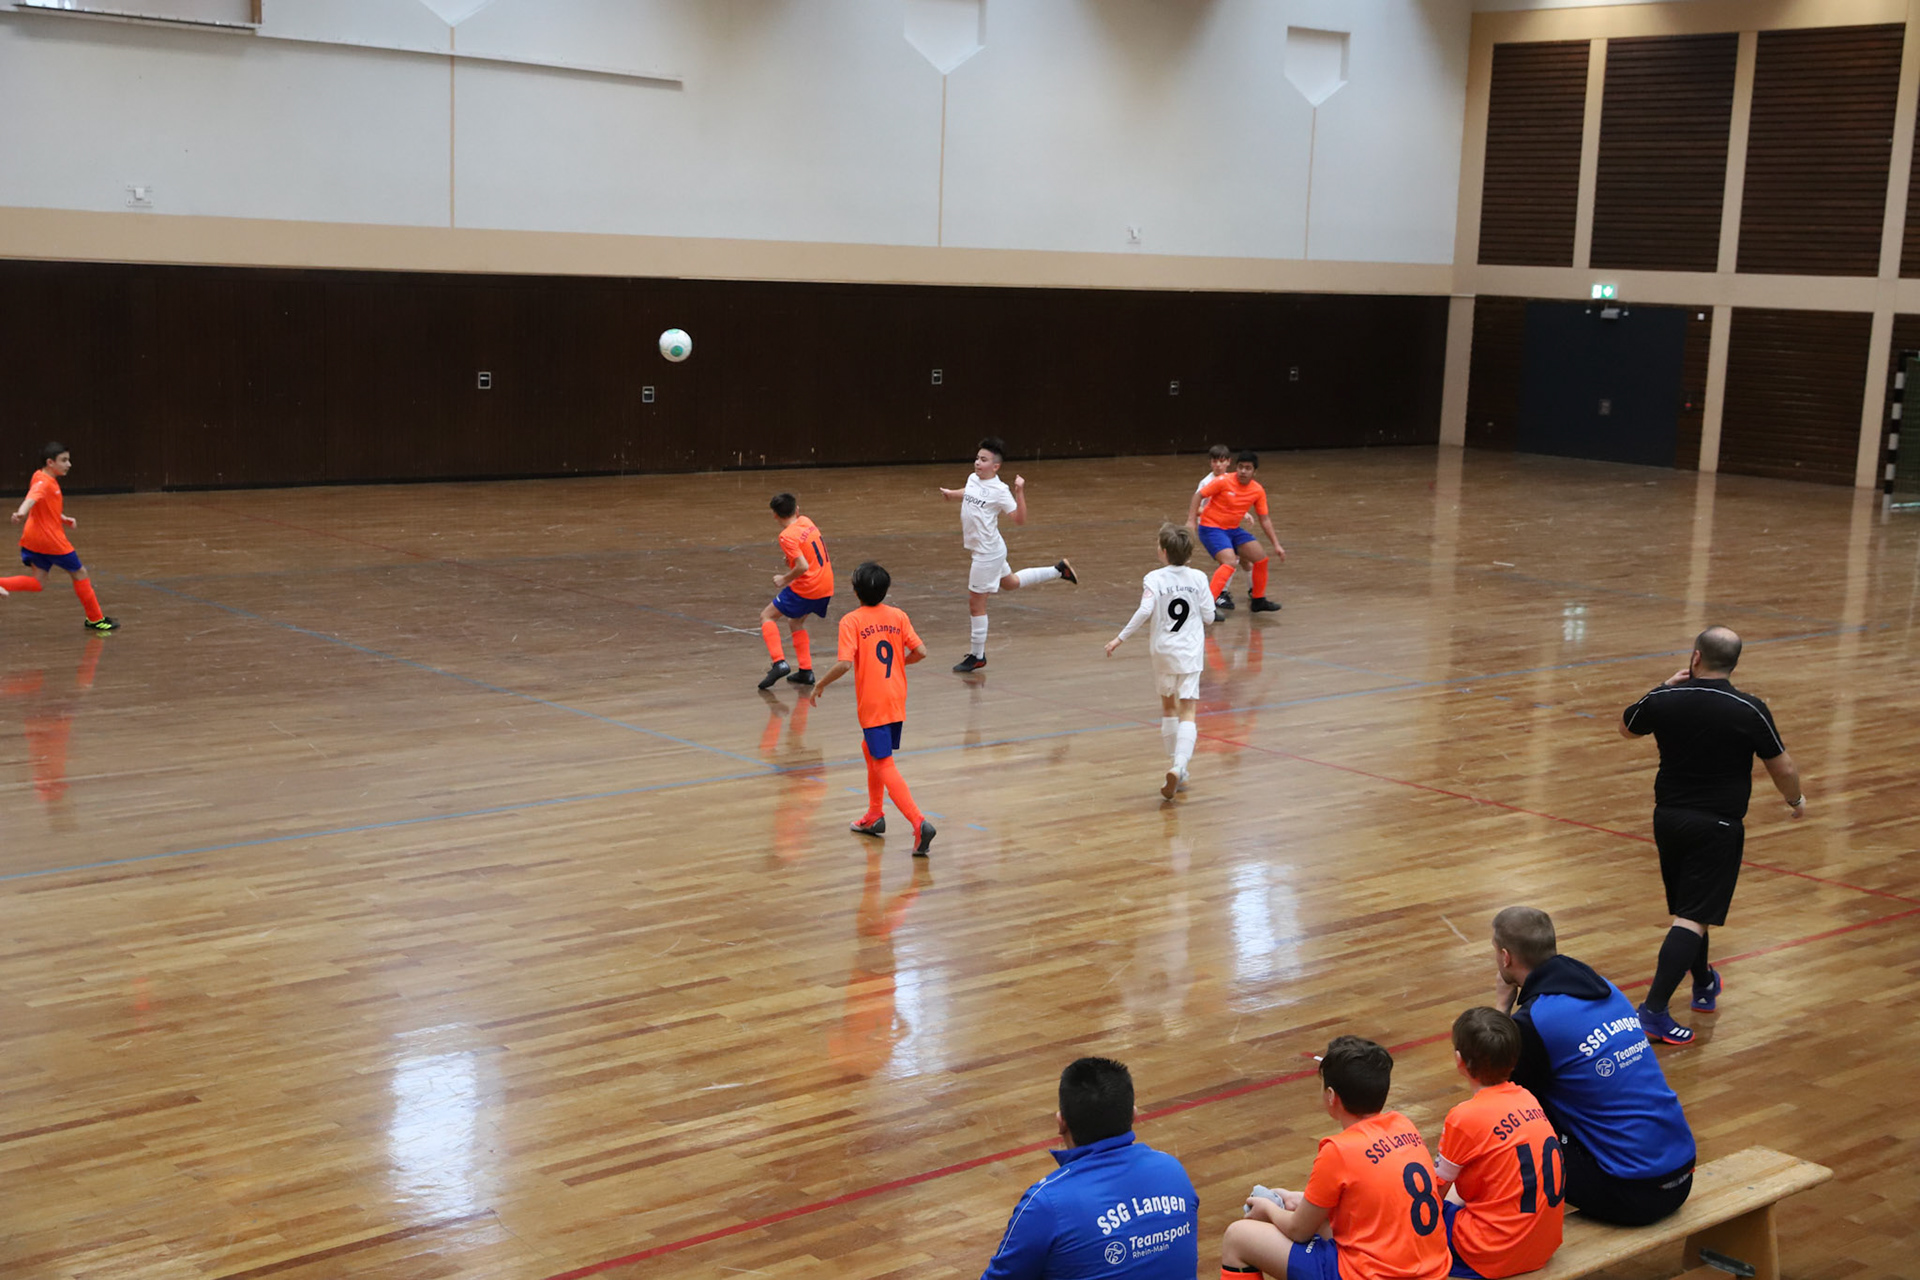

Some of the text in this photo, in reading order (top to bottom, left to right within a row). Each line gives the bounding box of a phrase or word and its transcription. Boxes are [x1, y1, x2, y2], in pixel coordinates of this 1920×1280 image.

[1168, 598, 1190, 632] 9
[860, 624, 901, 639] SSG Langen
[876, 640, 893, 678] 9
[1579, 1028, 1608, 1057] SSG
[1493, 1112, 1521, 1141] SSG
[1365, 1138, 1391, 1164] SSG
[1516, 1136, 1566, 1213] 10
[1403, 1162, 1439, 1236] 8
[1097, 1195, 1186, 1235] SSG Langen
[1129, 1221, 1191, 1250] Teamsport
[1132, 1243, 1170, 1259] Rhein-Main
